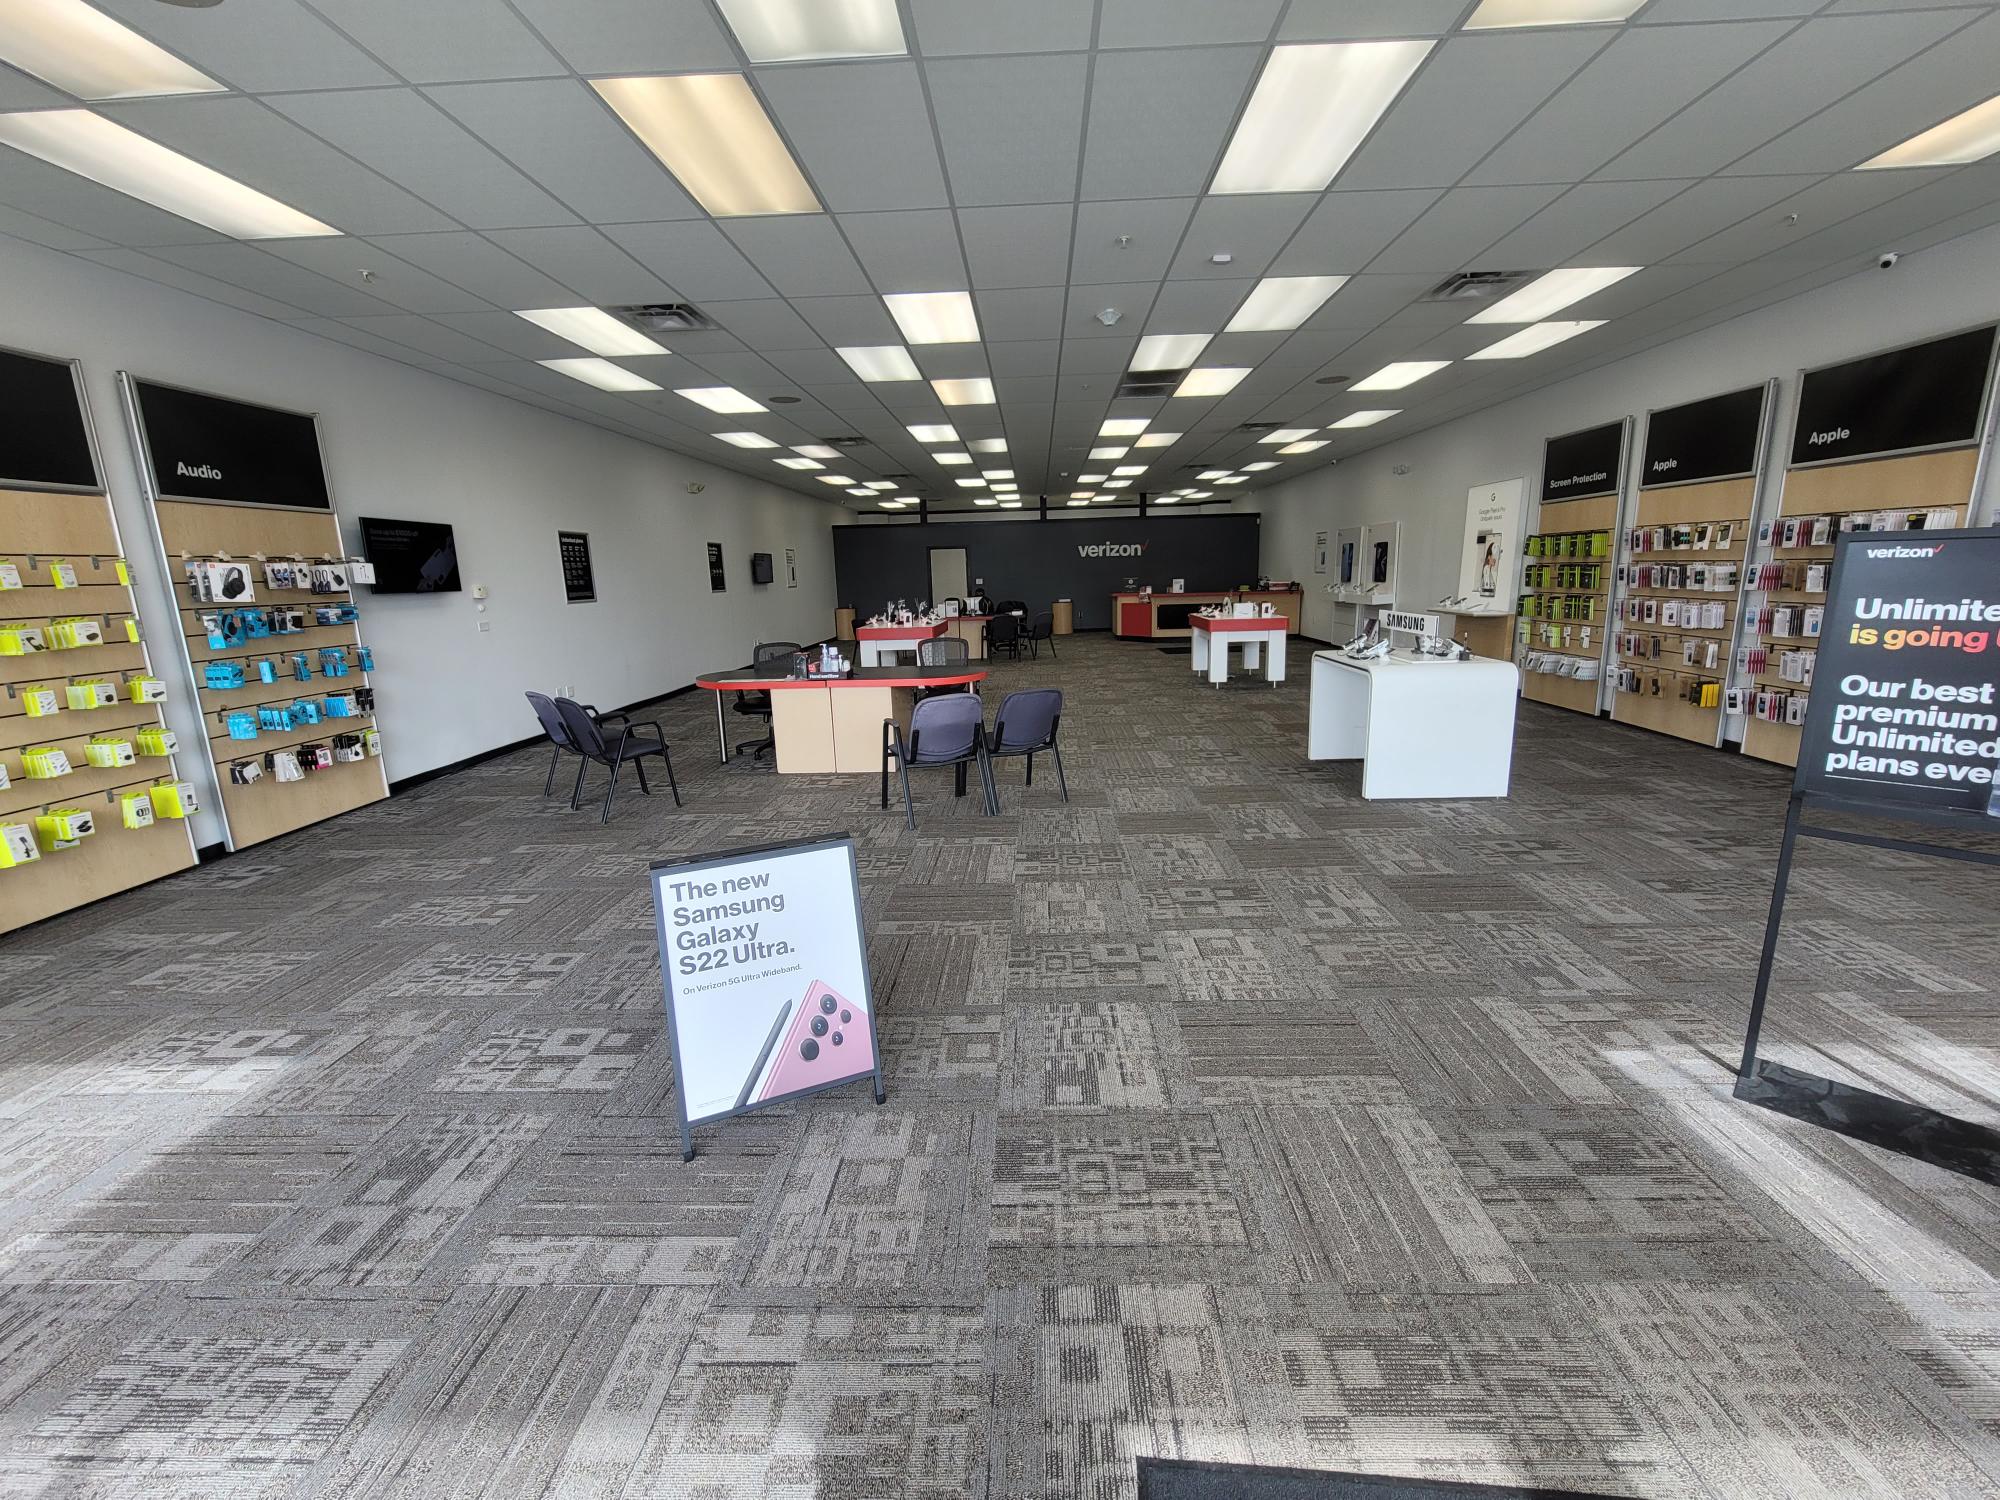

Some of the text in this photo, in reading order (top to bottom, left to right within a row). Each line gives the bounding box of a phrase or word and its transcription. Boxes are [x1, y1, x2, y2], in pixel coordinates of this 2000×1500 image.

[1808, 427, 1850, 445] Apple
[176, 461, 222, 481] Audio
[1652, 458, 1678, 472] Apple
[1550, 472, 1606, 488] Screen Protection
[1078, 541, 1142, 557] verizon
[1867, 545, 1934, 558] verizon
[1387, 614, 1425, 632] SAMSUNG
[1848, 624, 1878, 646] is
[1882, 625, 1989, 654] going
[1840, 674, 1995, 704] Our best
[1833, 703, 1998, 731] premium
[1830, 724, 2000, 759] Unlimited
[1825, 750, 1920, 778] plans
[670, 872, 770, 903] The new
[673, 892, 785, 927] Samsung
[676, 923, 759, 951] Galaxy
[679, 939, 796, 975] S22 Ultra.
[682, 964, 802, 996] On Verizon 5G Ultra Wideband.
